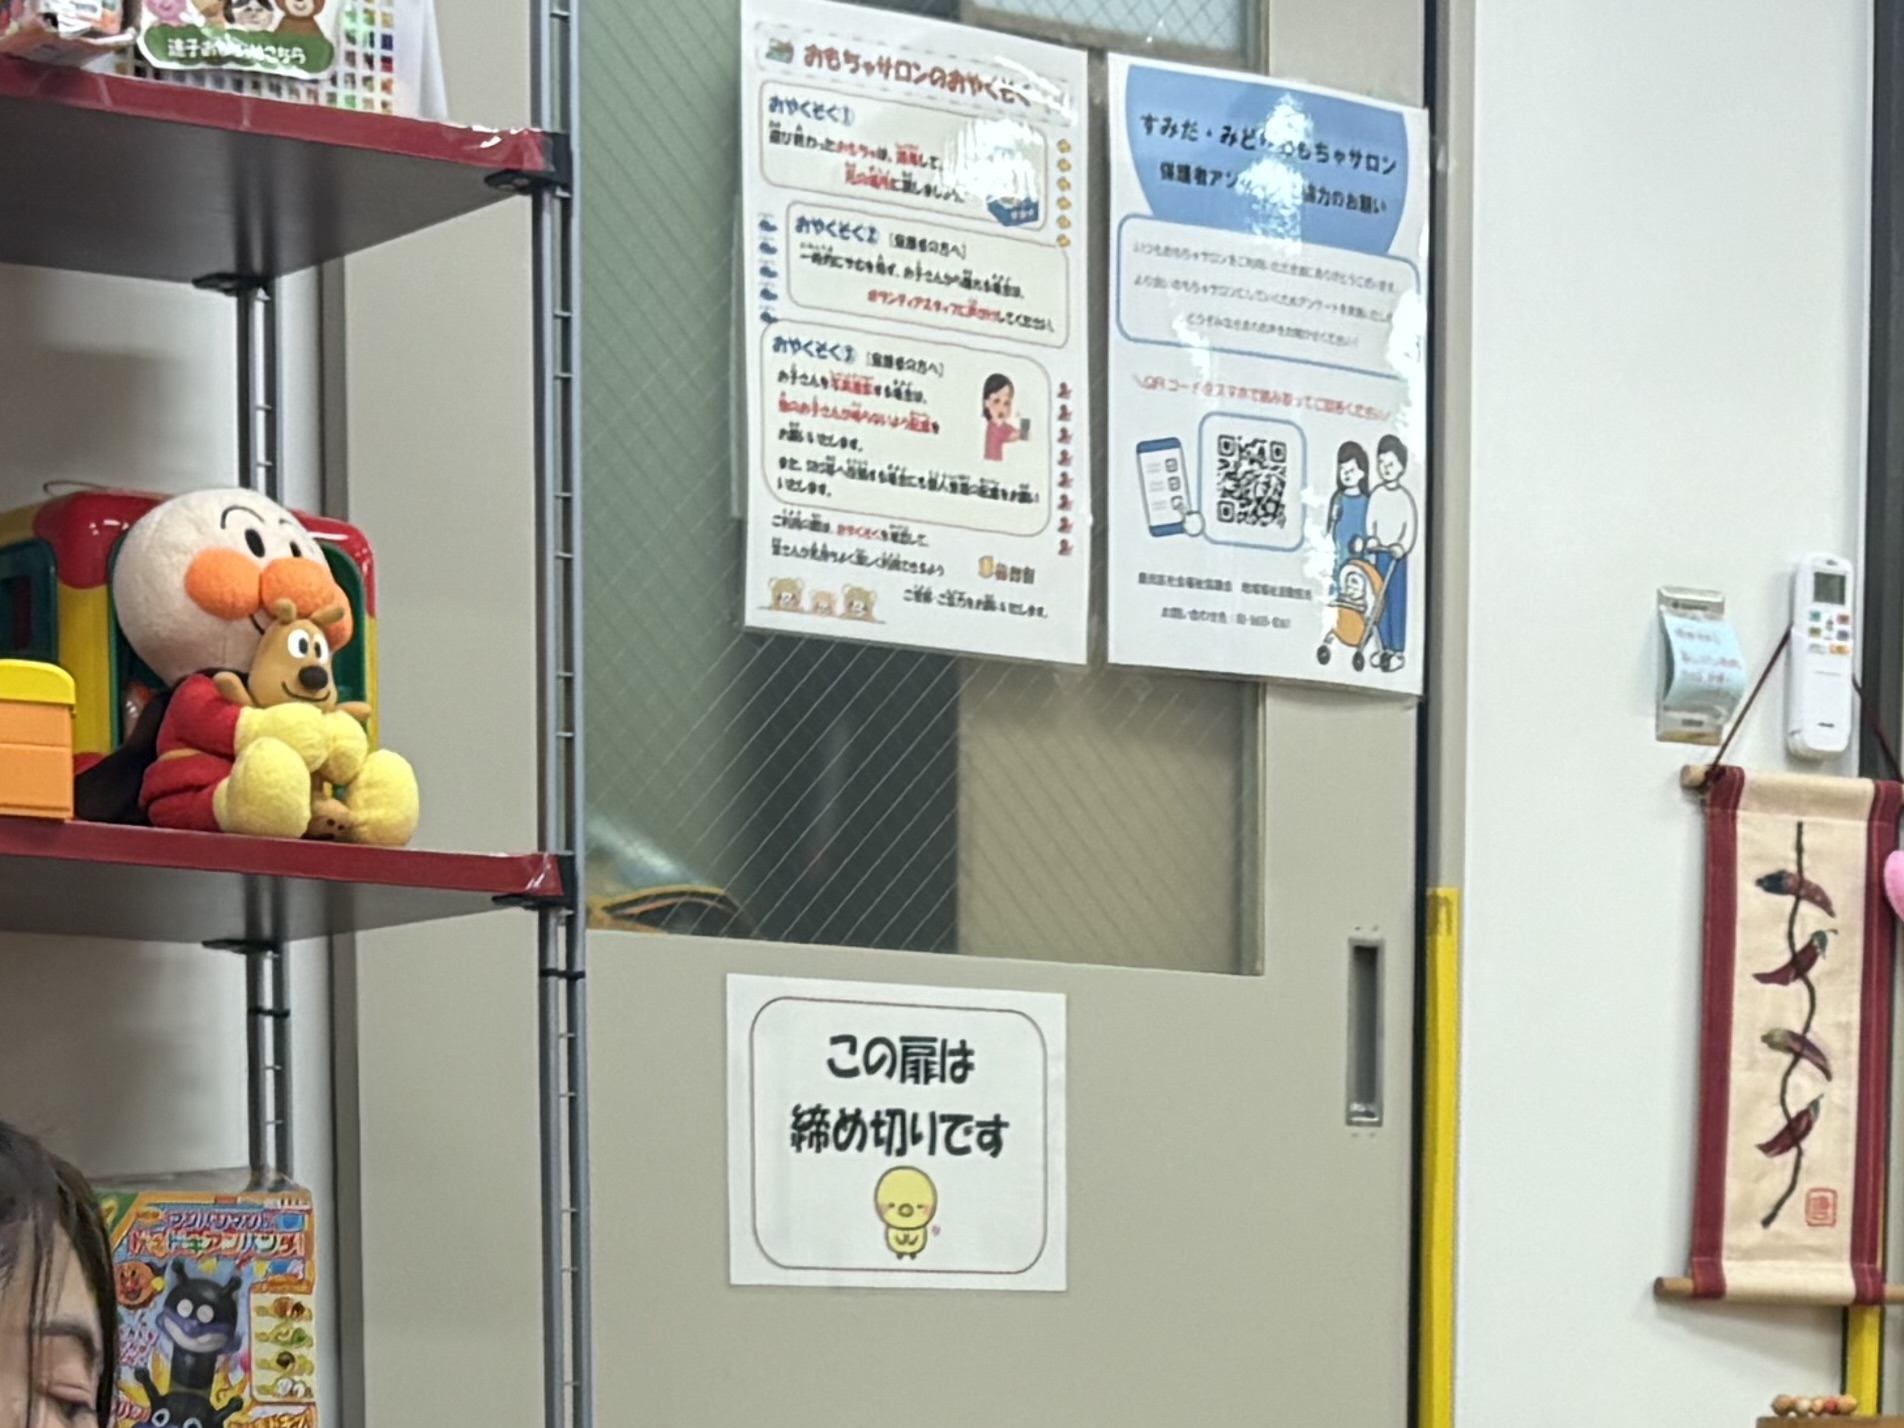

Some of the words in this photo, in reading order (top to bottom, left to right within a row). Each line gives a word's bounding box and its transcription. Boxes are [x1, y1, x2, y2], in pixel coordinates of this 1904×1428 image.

[825, 1032, 977, 1087] この扉は
[788, 1101, 1012, 1160] 締め切りです
